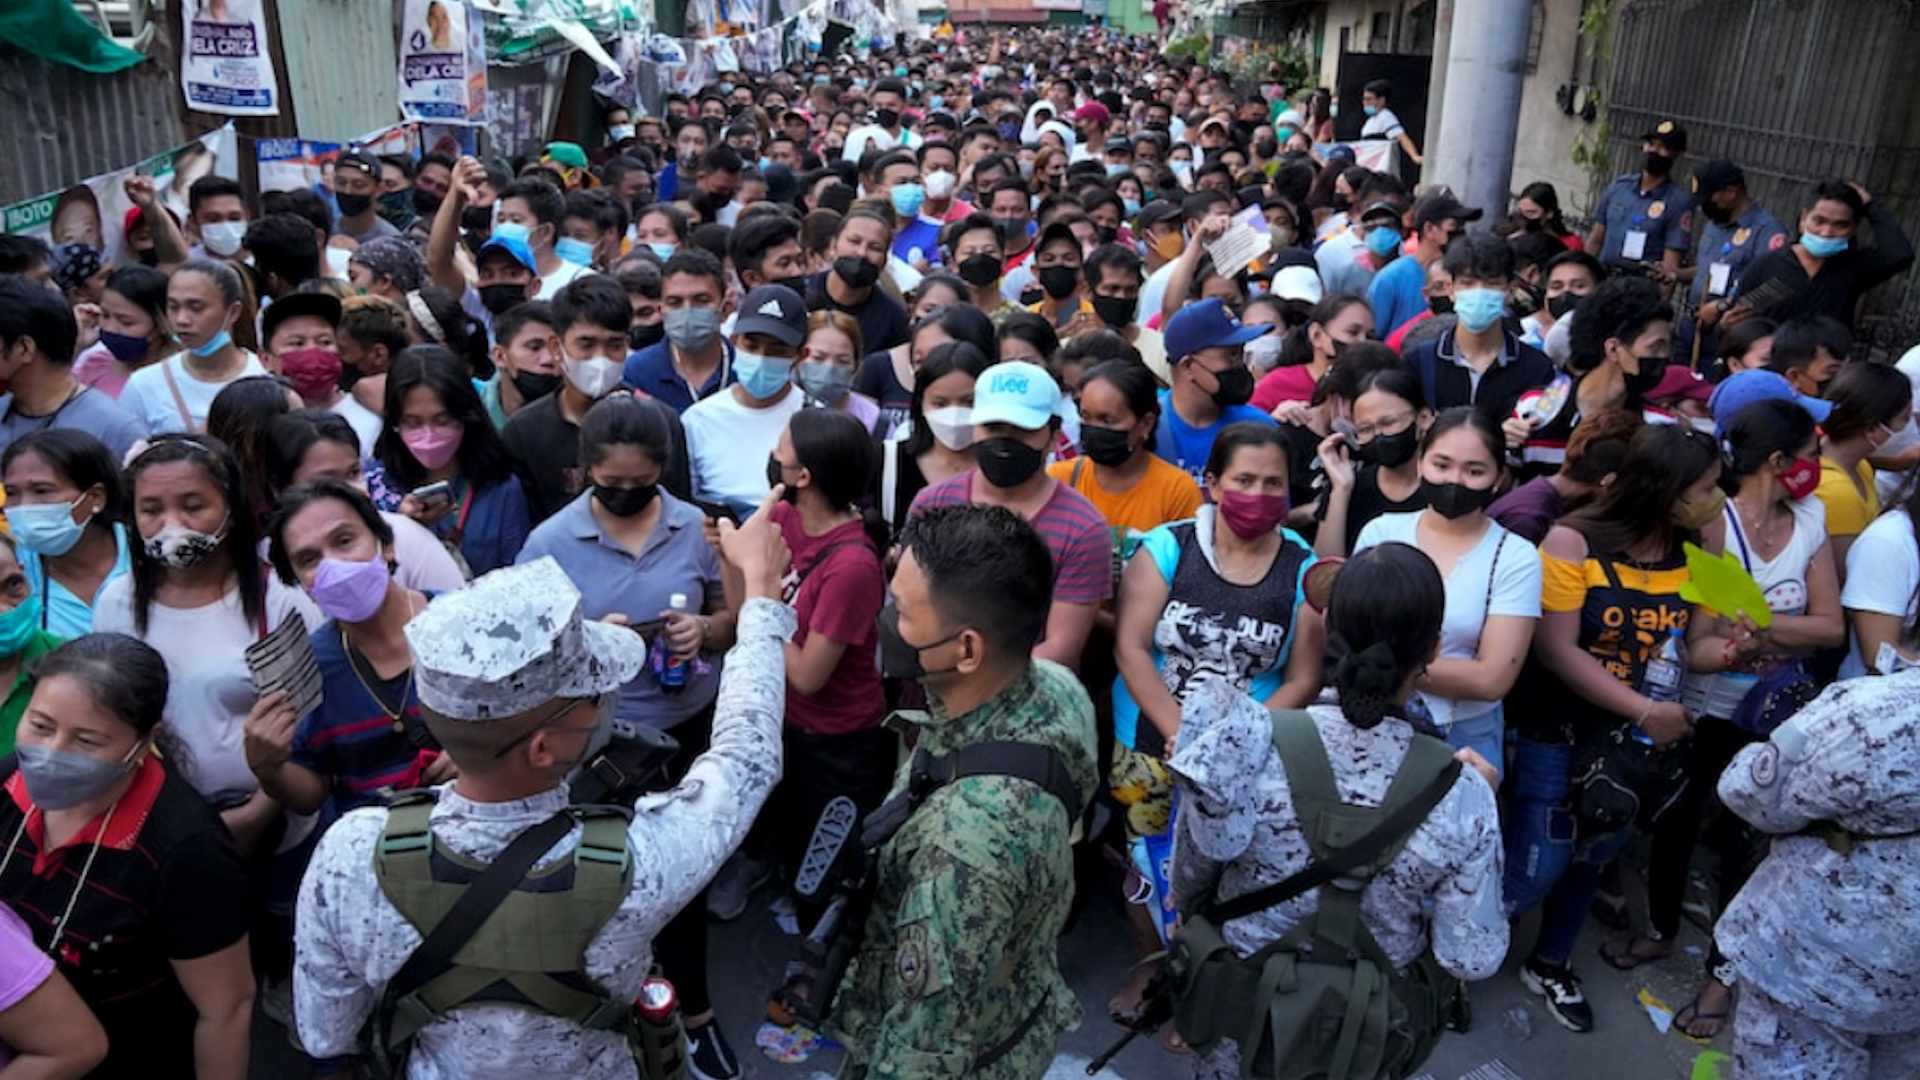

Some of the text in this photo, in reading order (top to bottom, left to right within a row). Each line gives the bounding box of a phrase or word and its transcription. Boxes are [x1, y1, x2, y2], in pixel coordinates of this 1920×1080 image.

[217, 40, 255, 56] CRUZ
[412, 31, 423, 50] 4
[405, 65, 440, 81] DELA
[8, 201, 52, 228] IBOTO
